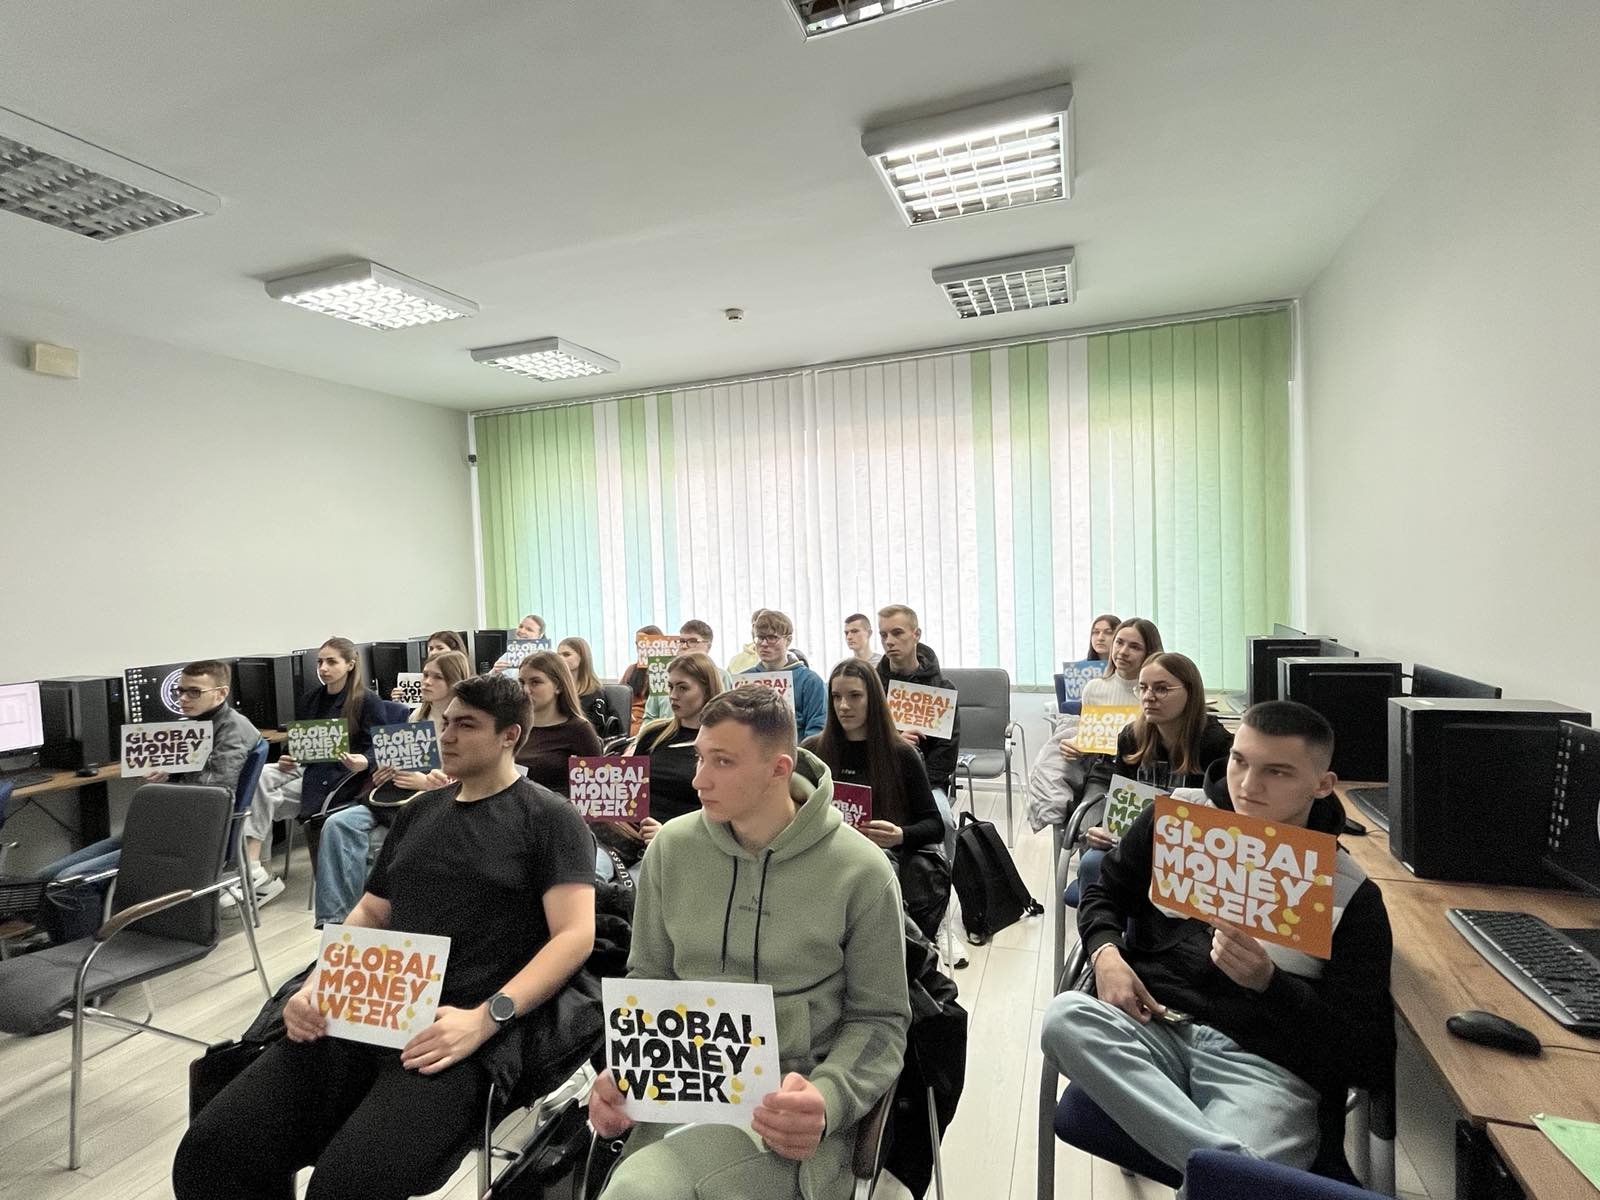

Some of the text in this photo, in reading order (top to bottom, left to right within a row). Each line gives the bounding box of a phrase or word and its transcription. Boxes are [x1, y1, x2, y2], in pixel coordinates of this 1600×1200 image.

[1064, 667, 1103, 678] GLOB
[891, 688, 954, 709] GLOBAL
[889, 700, 947, 718] MONEY
[125, 728, 211, 744] GLOBAL
[288, 725, 348, 739] GLOBAL
[372, 729, 436, 747] GLOBAL
[126, 741, 202, 757] MONEY
[288, 736, 343, 750] MONEY
[374, 742, 430, 760] MONEY
[125, 752, 190, 769] WEEK
[288, 748, 335, 760] WEEK
[376, 755, 424, 769] WEEK
[570, 766, 649, 783] GLOBAL
[570, 783, 641, 800] MONEY
[571, 799, 628, 816] WEEK
[832, 800, 867, 815] OBAL
[1156, 814, 1332, 886] GLOBAL
[1154, 842, 1312, 907] MONEY
[1153, 866, 1278, 933] WEEK
[323, 943, 441, 981] GLOBAL
[318, 969, 429, 1004] MONEY
[317, 992, 405, 1030] WEEK
[610, 1008, 765, 1045] GLOBAL
[611, 1038, 750, 1075] MONEY
[611, 1068, 731, 1104] WEEK
